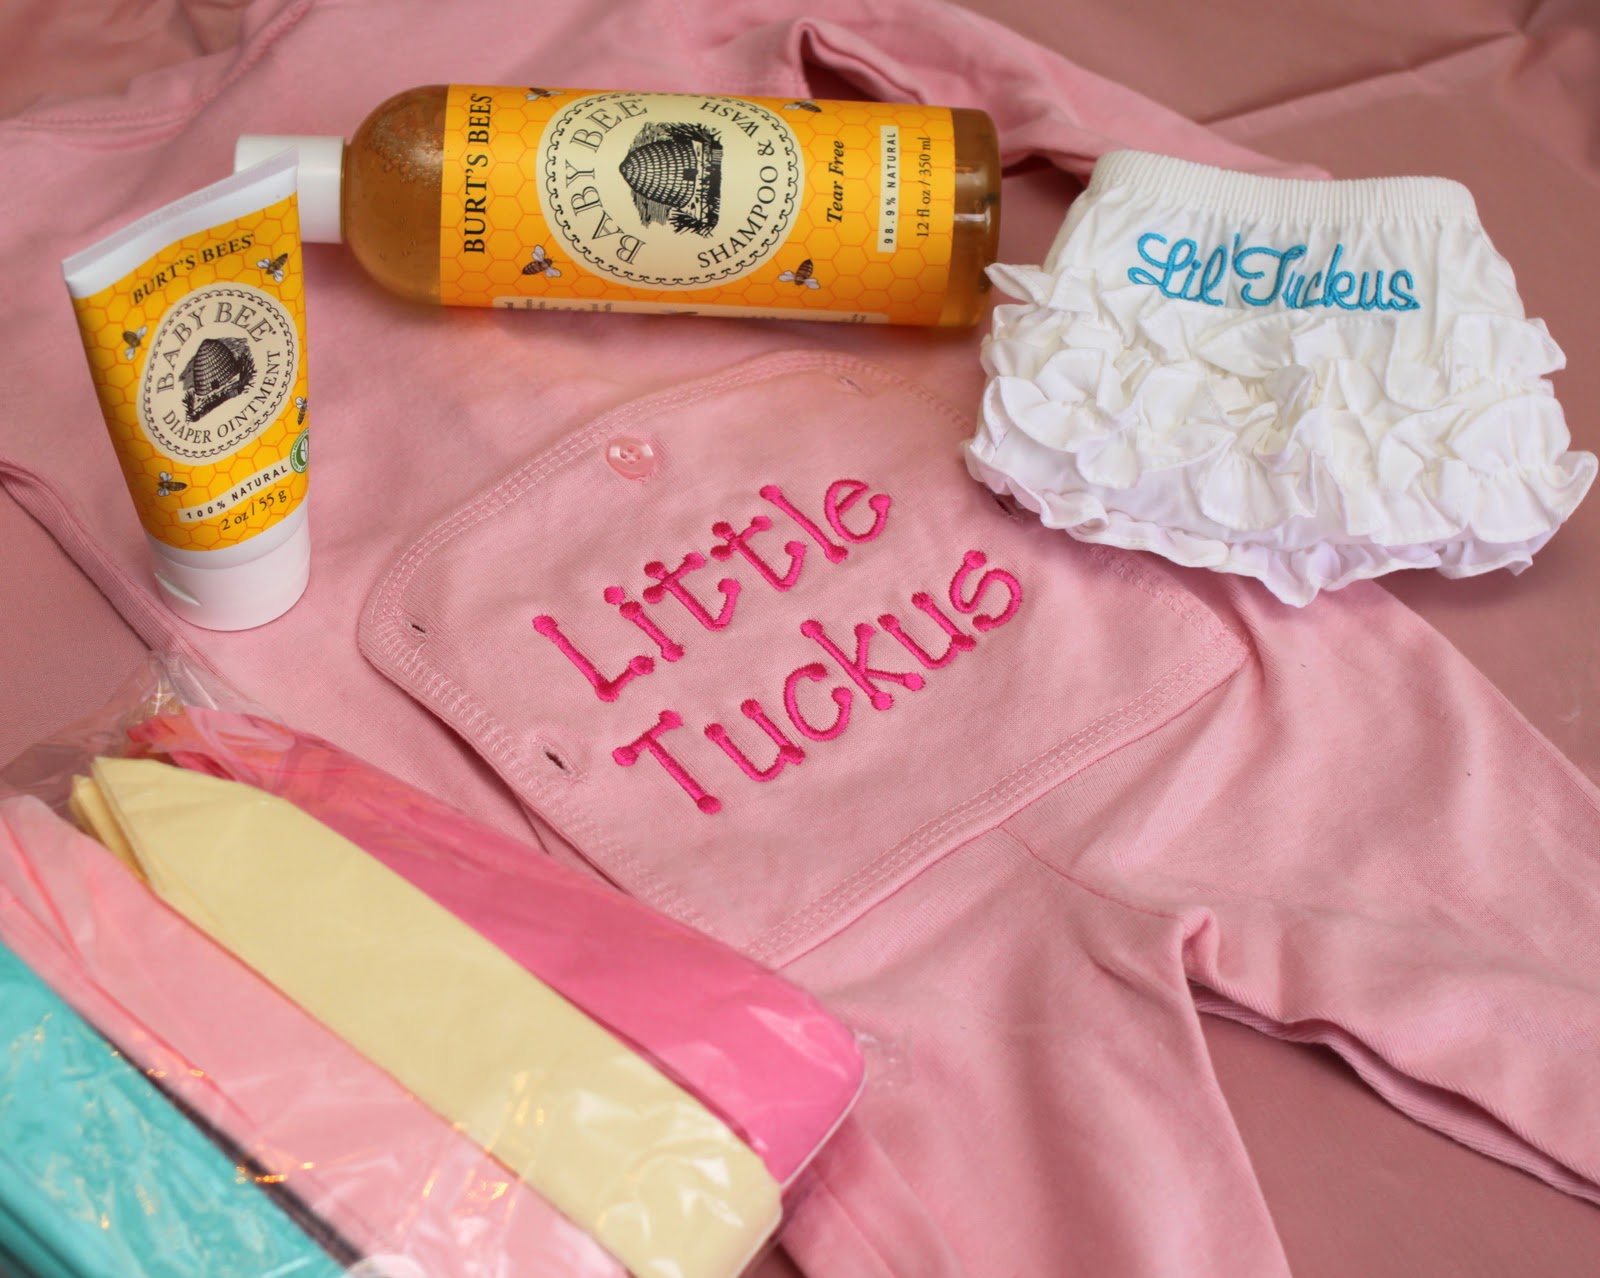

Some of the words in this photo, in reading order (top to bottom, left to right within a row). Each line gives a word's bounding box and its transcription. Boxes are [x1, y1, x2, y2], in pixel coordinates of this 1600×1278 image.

[468, 93, 492, 144] BEES
[569, 98, 648, 154] BEE
[700, 101, 760, 138] WASH
[917, 137, 931, 151] ml
[757, 139, 775, 156] &
[828, 140, 845, 176] Free
[886, 133, 896, 188] NATURAL
[918, 154, 932, 177] 350
[463, 153, 488, 254] BURT'S
[565, 159, 646, 265] BABY
[697, 165, 778, 268] SHAMPOO
[826, 181, 844, 223] Tear
[884, 197, 897, 244] 98.9%
[916, 207, 930, 219] fl
[922, 191, 931, 205] oz
[916, 222, 929, 237] 12
[133, 254, 196, 305] BURT'S
[201, 235, 254, 264] BEES
[1233, 243, 1421, 311] Tuckus
[157, 305, 206, 395] BABY
[214, 302, 274, 343] BEE
[162, 410, 212, 444] DIAPER
[217, 350, 281, 438] OINTMENT
[186, 501, 226, 519] 100%
[231, 465, 288, 501] NATURAL
[221, 518, 230, 530] 2
[234, 512, 249, 525] oz
[259, 494, 275, 511] 55
[279, 490, 288, 503] g
[533, 479, 891, 702] Little
[612, 550, 1023, 815] Tuckus
